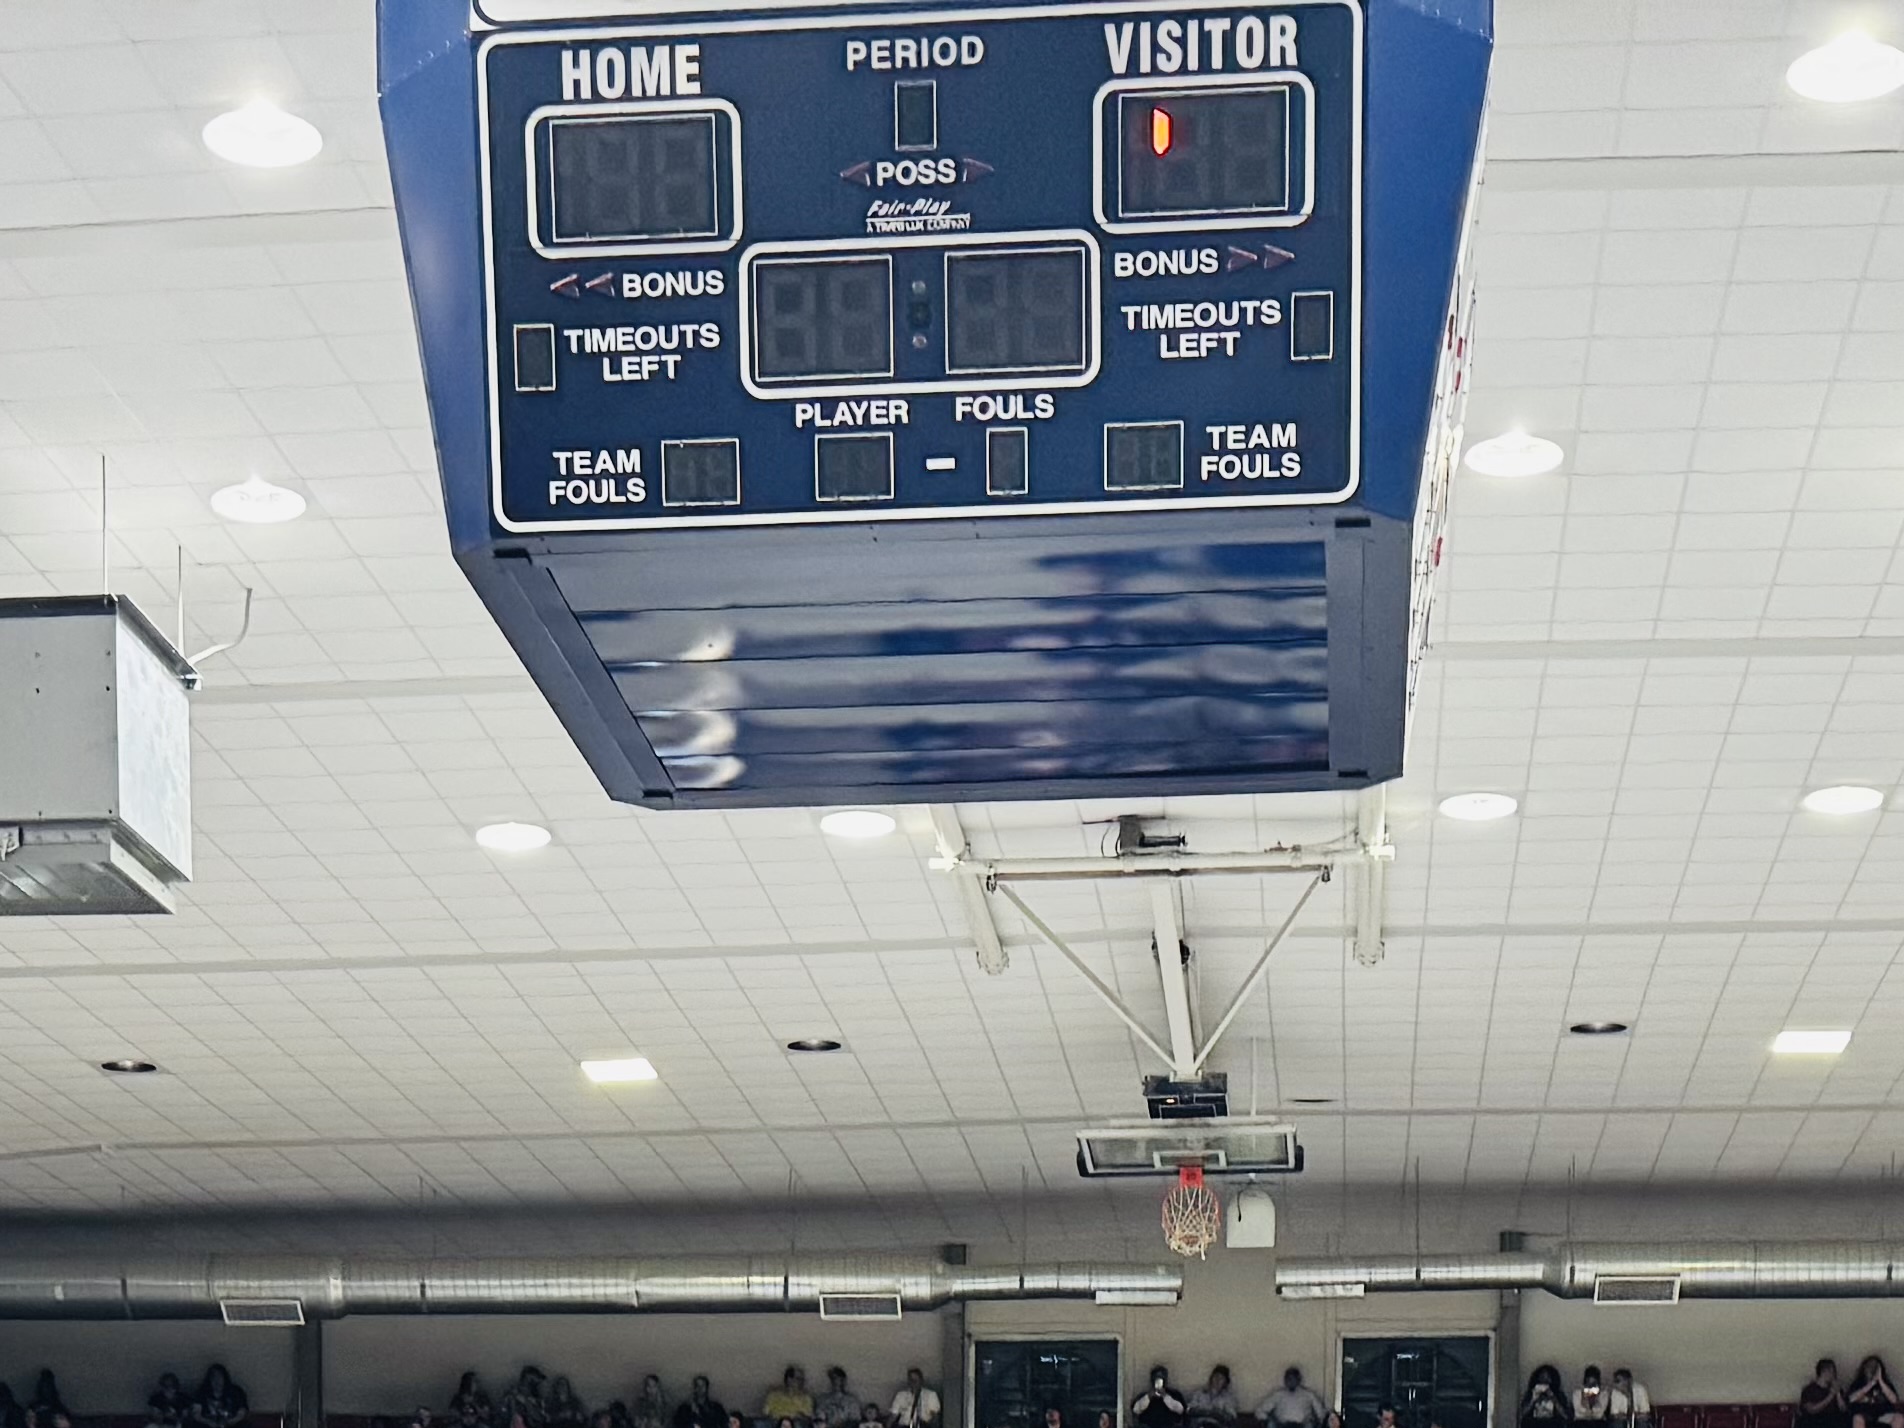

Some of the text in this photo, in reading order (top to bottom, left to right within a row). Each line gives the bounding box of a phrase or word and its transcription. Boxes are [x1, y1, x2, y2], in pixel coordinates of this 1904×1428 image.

[847, 36, 983, 70] PERIOD
[1104, 15, 1298, 74] VISITOR
[561, 44, 702, 101] HOME
[877, 159, 956, 186] POSS
[1115, 249, 1218, 277] BONUS
[623, 270, 724, 297] BONUS
[1121, 300, 1281, 330] TIMEOUTS
[564, 323, 720, 353] TIMEOUTS
[1161, 332, 1240, 358] LEFT
[603, 355, 681, 381] LEFT
[796, 394, 1054, 427] PLAYER FOULS
[1206, 423, 1296, 450] TEAM
[553, 449, 640, 475] TEAM
[1201, 453, 1300, 480] FOULS
[550, 478, 645, 504] FOULS
